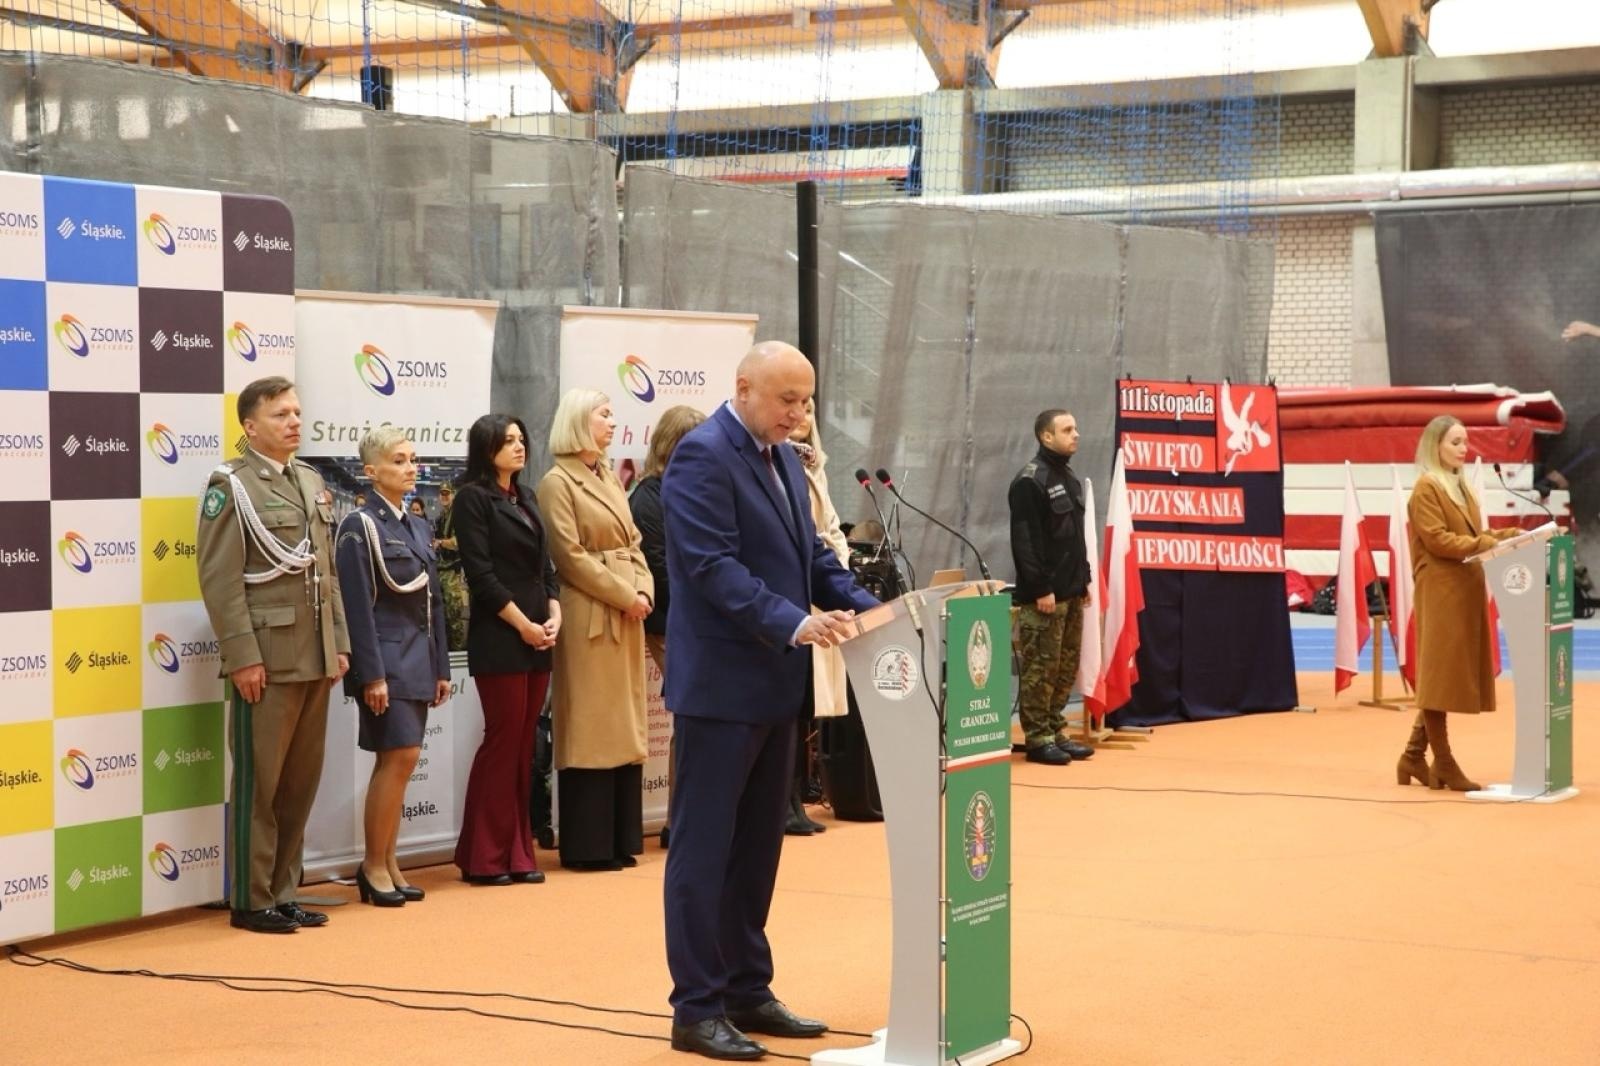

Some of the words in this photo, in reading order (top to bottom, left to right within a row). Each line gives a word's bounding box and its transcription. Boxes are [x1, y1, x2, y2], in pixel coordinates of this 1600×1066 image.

[0, 211, 38, 229] SOMS
[81, 220, 126, 241] Śląskie.
[177, 226, 217, 242] ZSOMS
[254, 232, 292, 252] Śląskie.
[0, 326, 36, 345] ąskie.
[91, 327, 134, 343] ZSOMS
[172, 330, 213, 351] Śląskie.
[258, 333, 295, 348] ZSOMS
[397, 361, 447, 379] ZSOMS
[657, 370, 706, 386] ZSOMS
[85, 435, 129, 455] Śląskie.
[180, 434, 219, 449] ZSOMS
[1124, 433, 1203, 476] ŚWIĘTO
[0, 548, 40, 566] ląskie.
[94, 541, 136, 557] ZSOMS
[174, 539, 196, 559] Śląs
[180, 640, 220, 656] ZSOMS
[1, 654, 47, 672] ZSOMS
[88, 652, 130, 670] Śląskie.
[969, 695, 991, 711] STRAŻ
[960, 712, 999, 728] GRANICZNA
[95, 753, 137, 772] ZSOMS
[174, 747, 215, 767] Śląskie.
[402, 801, 439, 821] ląskie.
[181, 845, 220, 864] ZSOMS
[89, 864, 132, 885] Śląskie.
[4, 874, 49, 895] ZSOMS
